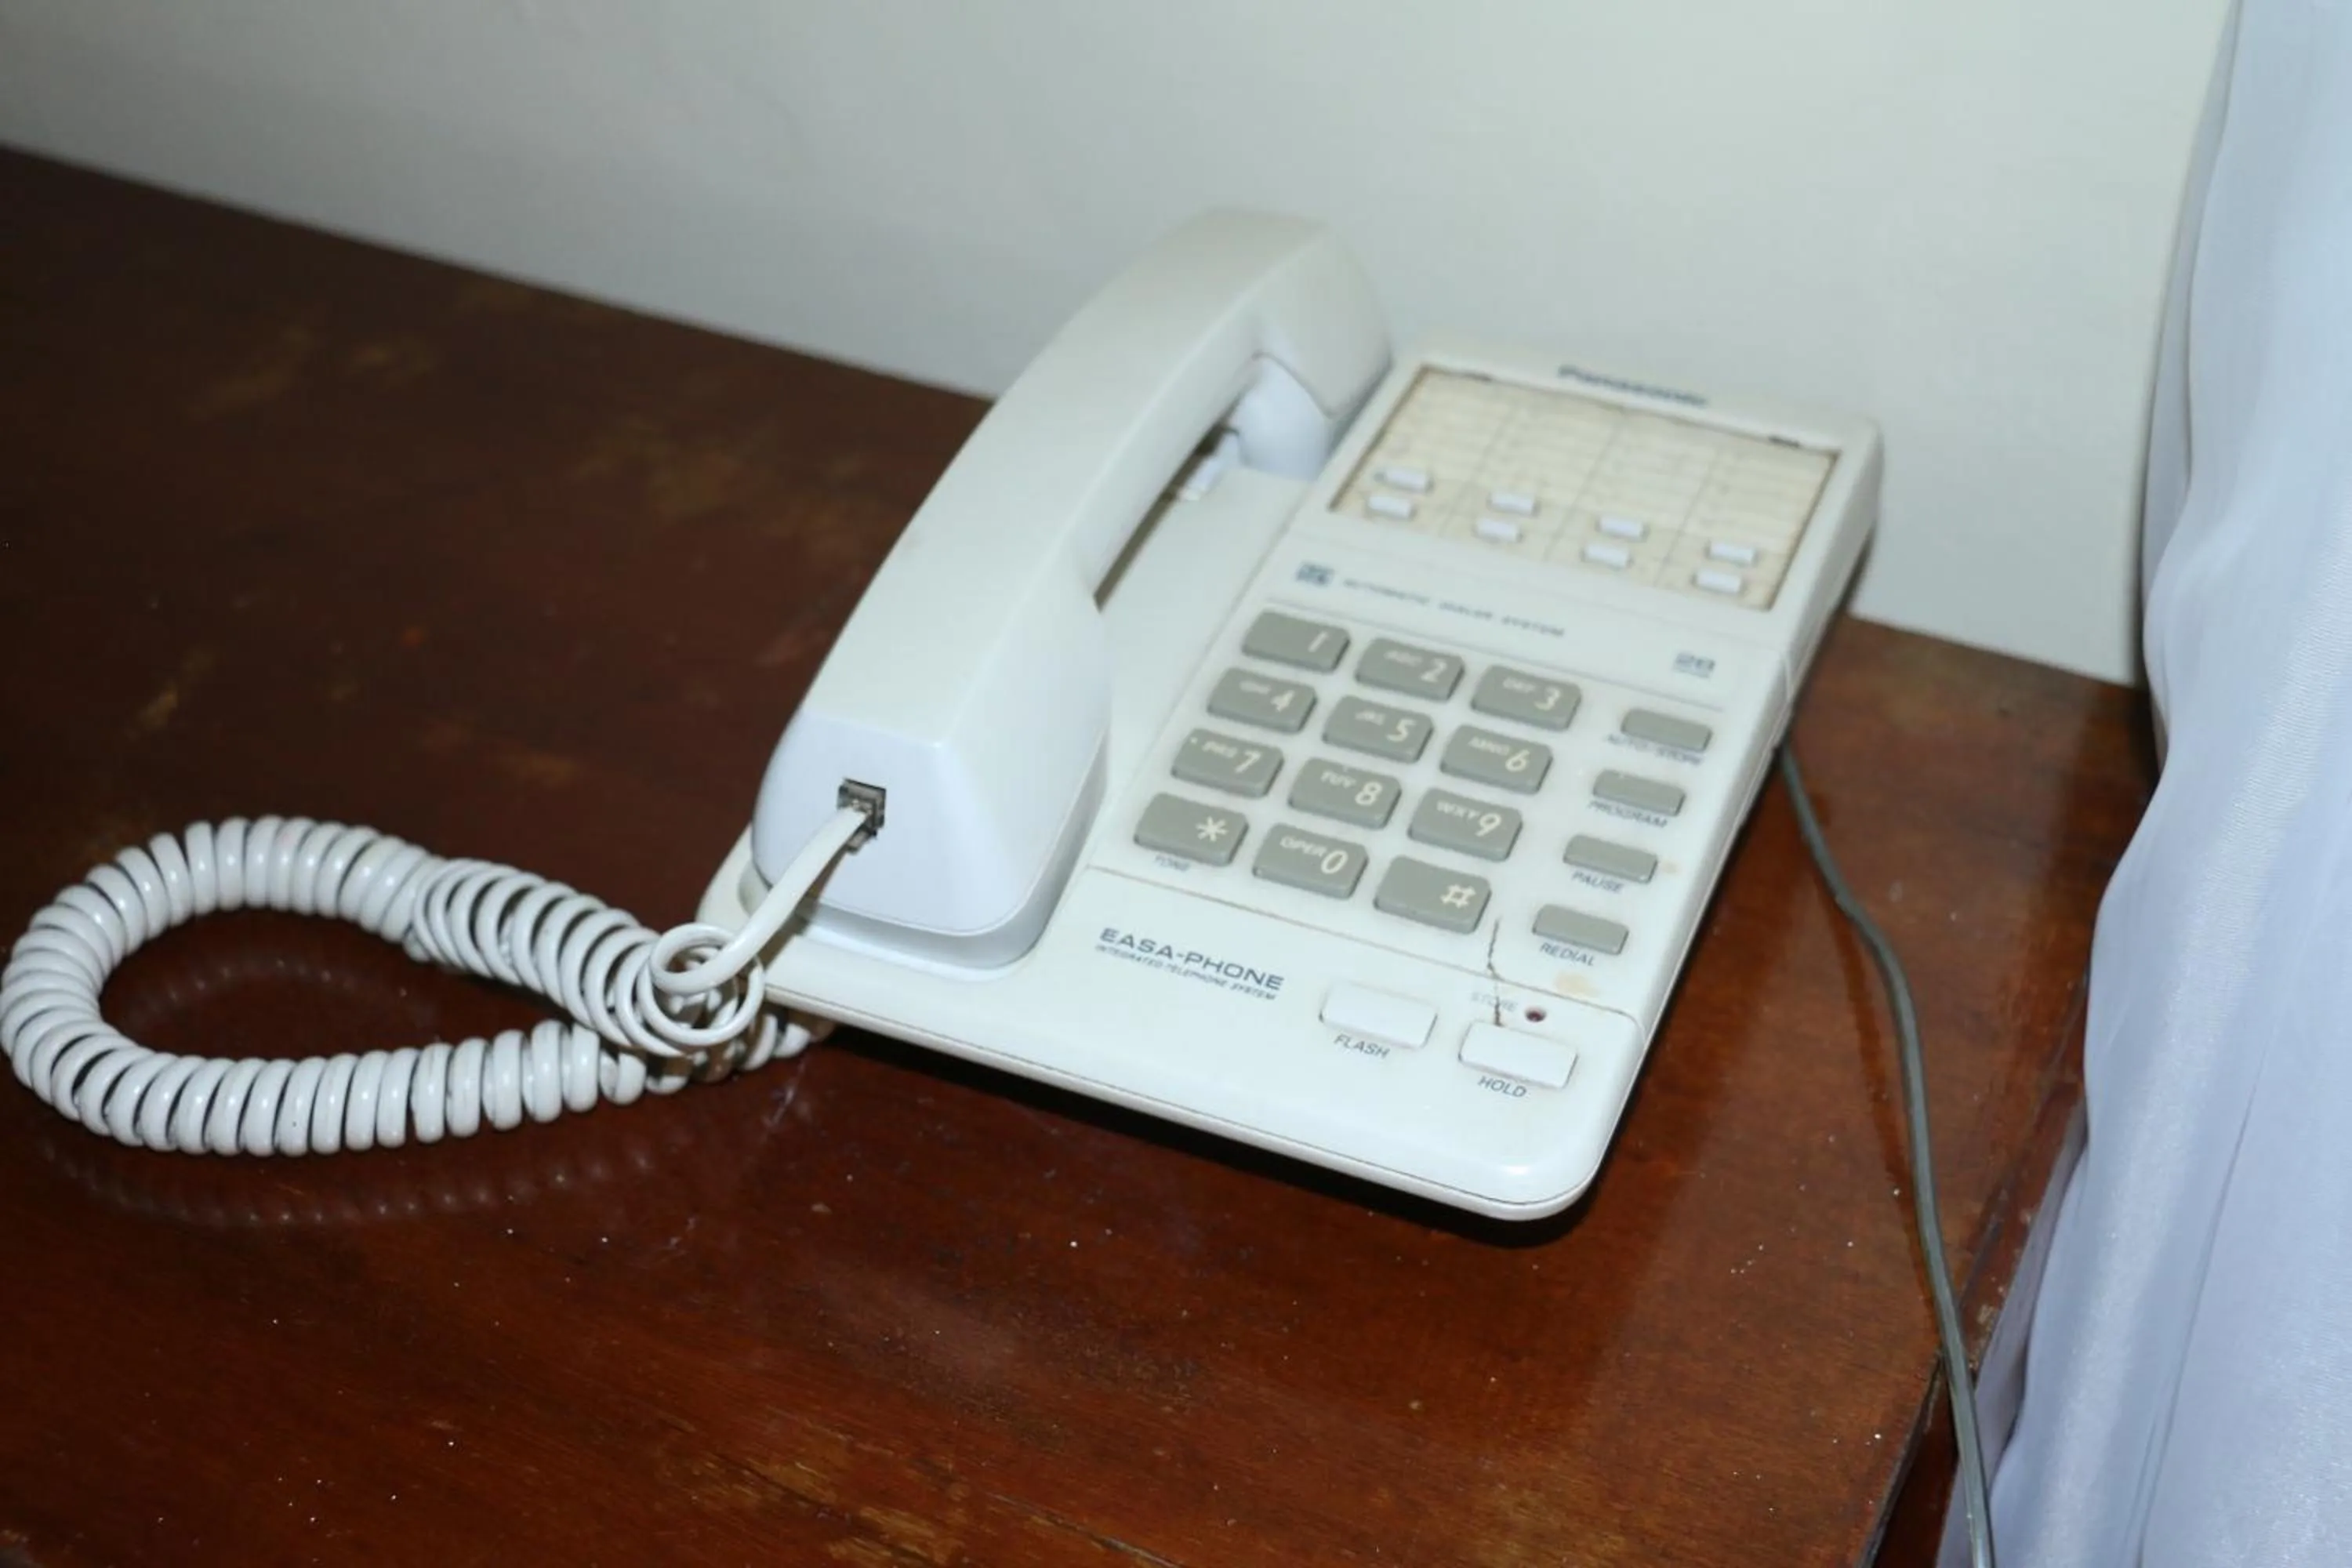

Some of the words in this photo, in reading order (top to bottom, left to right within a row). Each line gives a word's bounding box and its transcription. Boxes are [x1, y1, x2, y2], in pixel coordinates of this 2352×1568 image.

[1308, 630, 1328, 653] 1
[1419, 658, 1447, 682] 2
[1270, 690, 1295, 713] 4
[1534, 685, 1563, 711] 3
[1385, 718, 1418, 742] 5
[1234, 750, 1261, 774] 7
[1505, 749, 1530, 772] 6
[1355, 781, 1383, 806] 8
[1475, 812, 1502, 837] 9
[1588, 800, 1668, 827] PROGRAM
[1279, 836, 1326, 858] OPER
[1320, 850, 1348, 874] 0
[1571, 871, 1624, 893] PAUSE
[1440, 884, 1476, 907] #
[1100, 927, 1284, 990] EASA-PHONE
[1540, 942, 1595, 966] REDIAL
[1230, 982, 1276, 1001] SYSTEM
[1334, 1034, 1391, 1058] FLASH
[1477, 1076, 1527, 1098] HOLD
